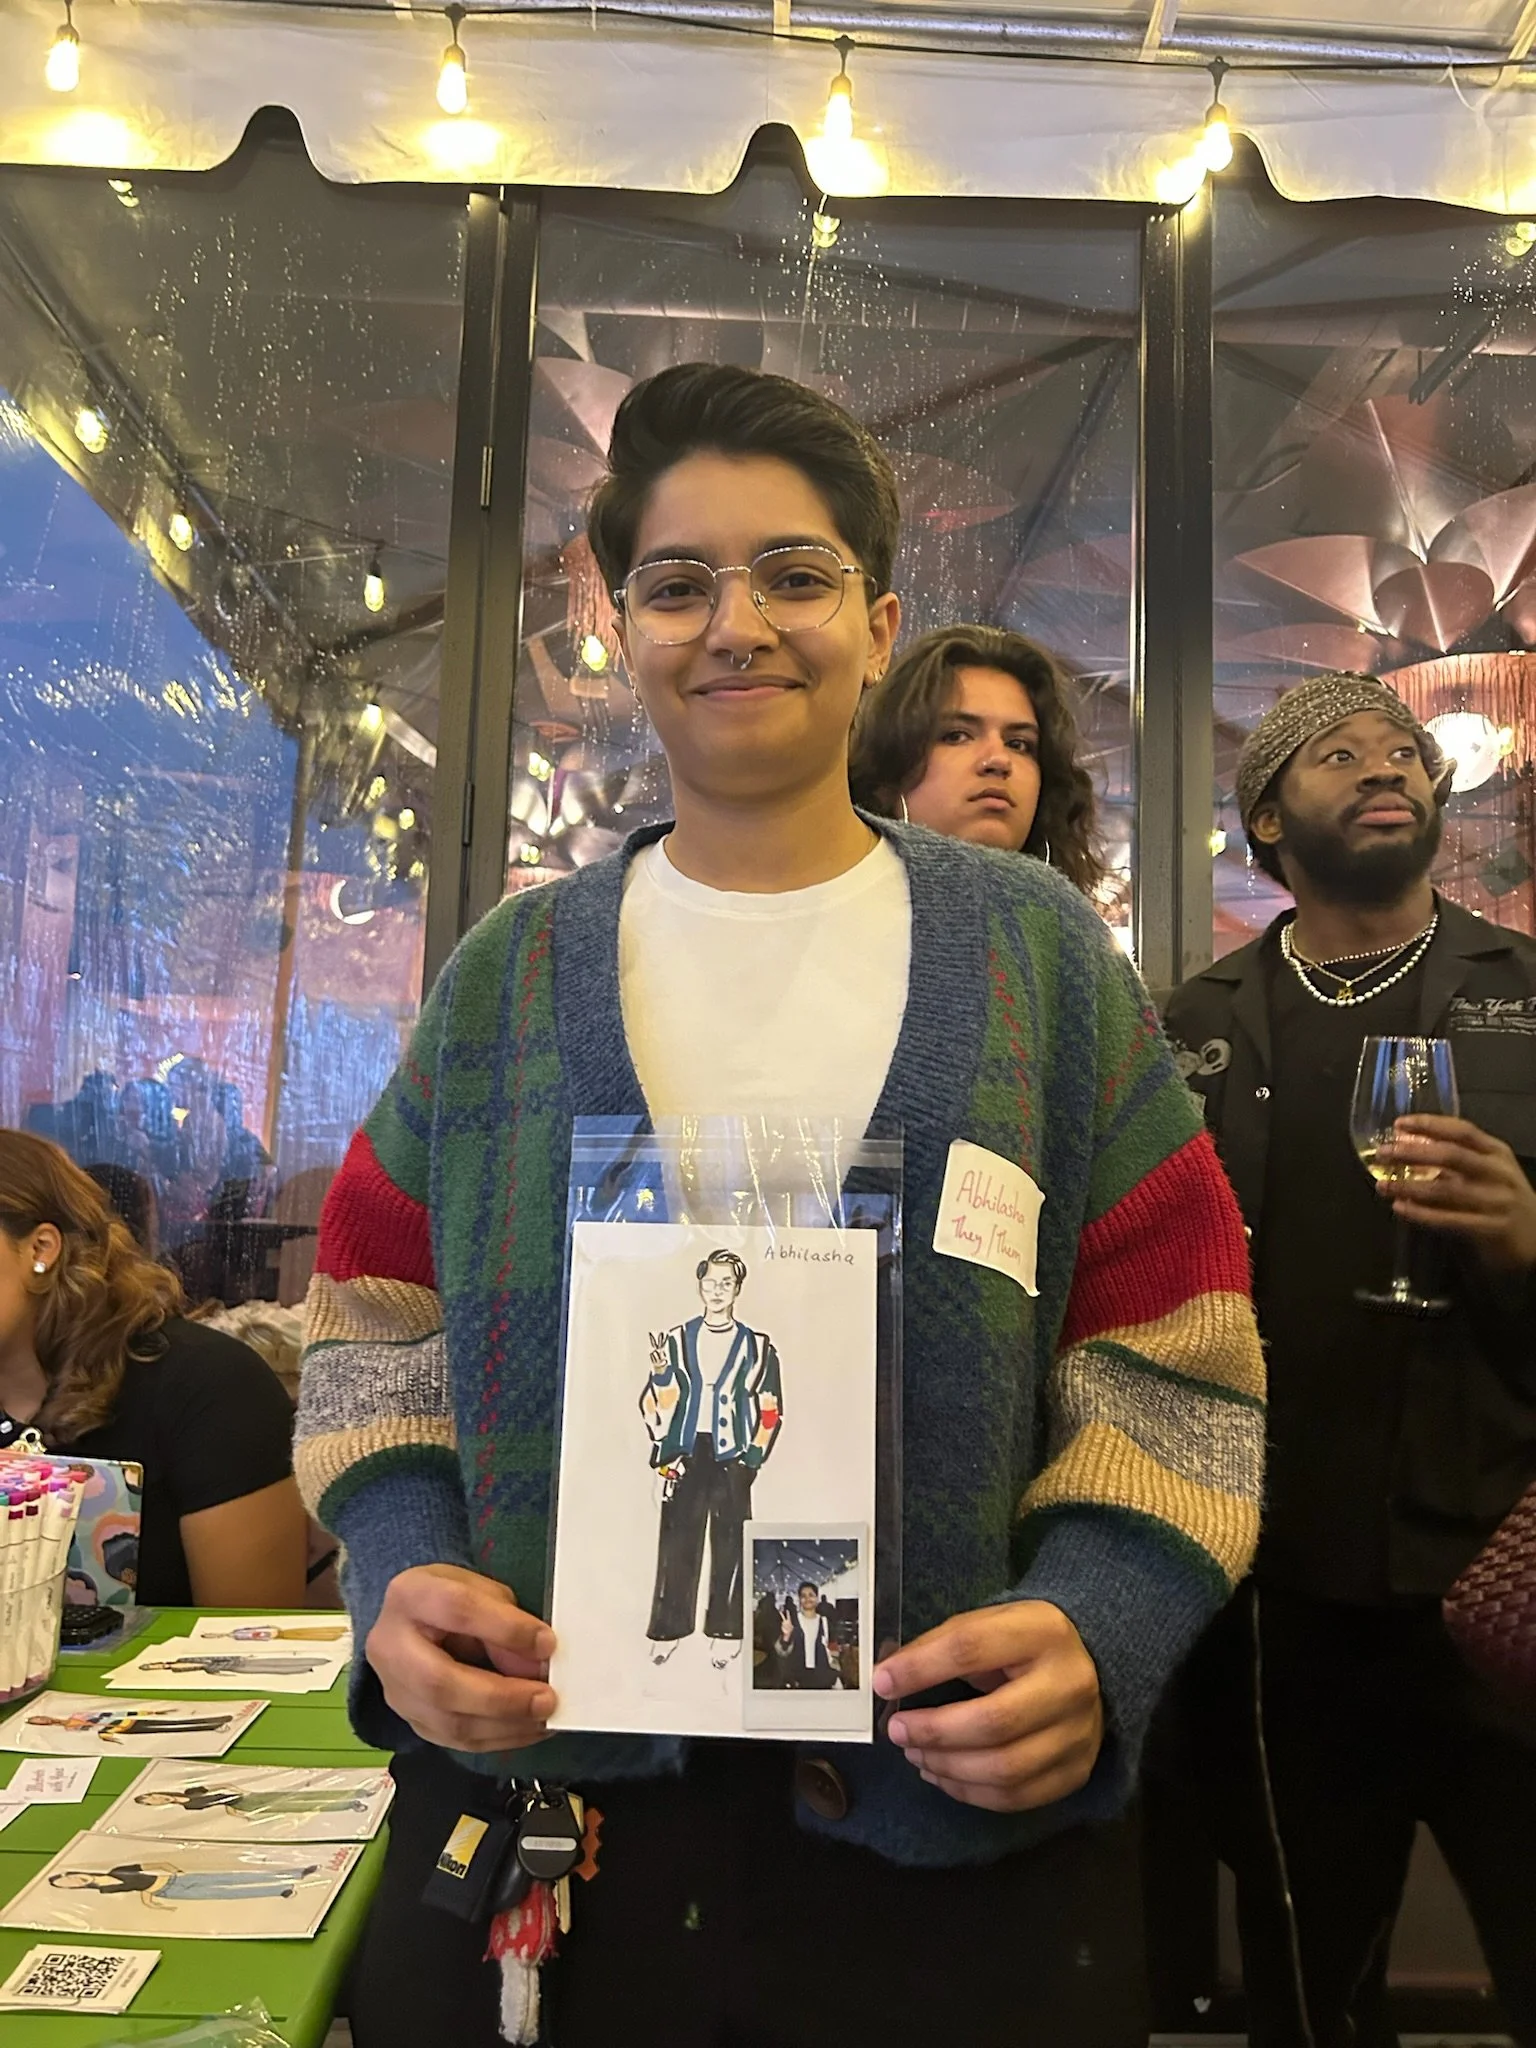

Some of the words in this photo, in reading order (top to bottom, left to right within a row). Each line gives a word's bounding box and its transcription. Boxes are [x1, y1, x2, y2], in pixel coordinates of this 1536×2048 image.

[956, 1169, 1026, 1226] Abhilasha
[764, 1244, 855, 1266] Abhilasha
[440, 1852, 467, 1876] Nikon
